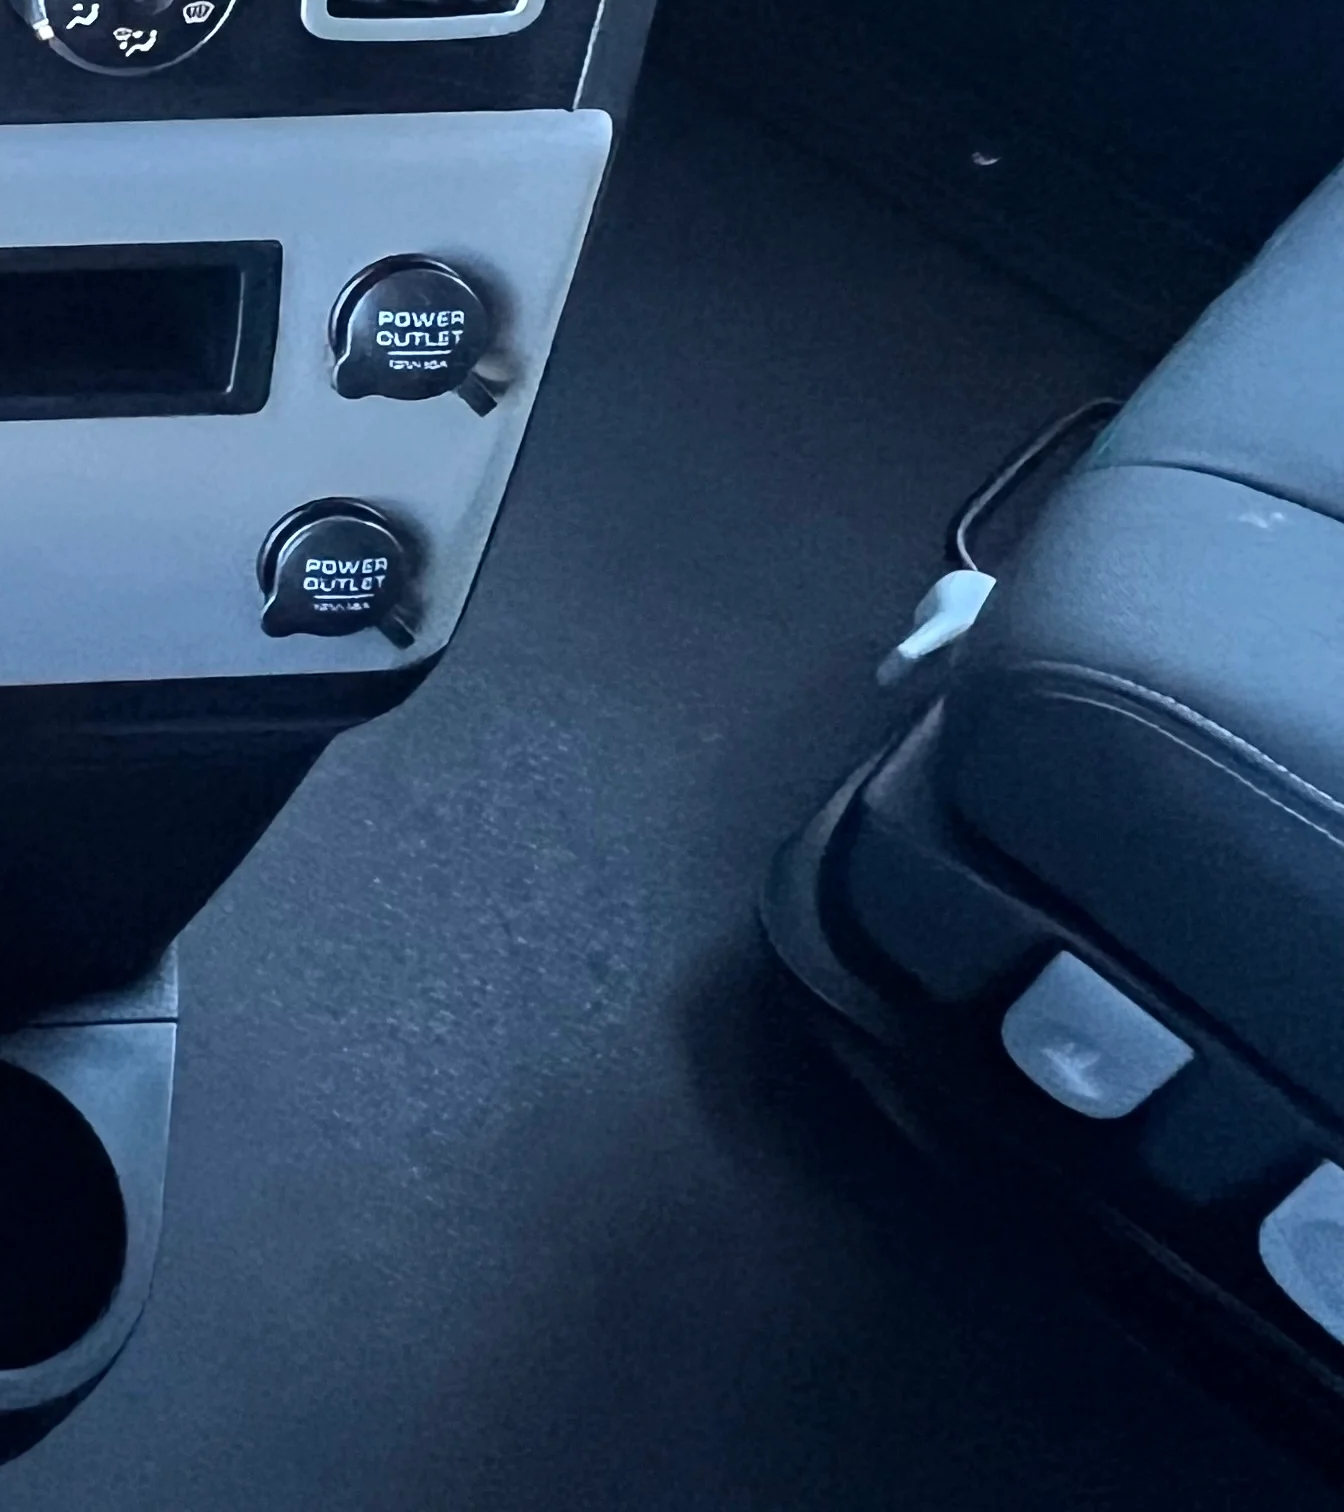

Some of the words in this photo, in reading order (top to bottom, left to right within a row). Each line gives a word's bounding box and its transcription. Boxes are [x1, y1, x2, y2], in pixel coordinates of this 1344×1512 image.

[377, 309, 465, 328] POWER
[375, 330, 465, 347] OUTLET
[305, 557, 388, 575] POWER
[303, 575, 387, 592] OUTLET
